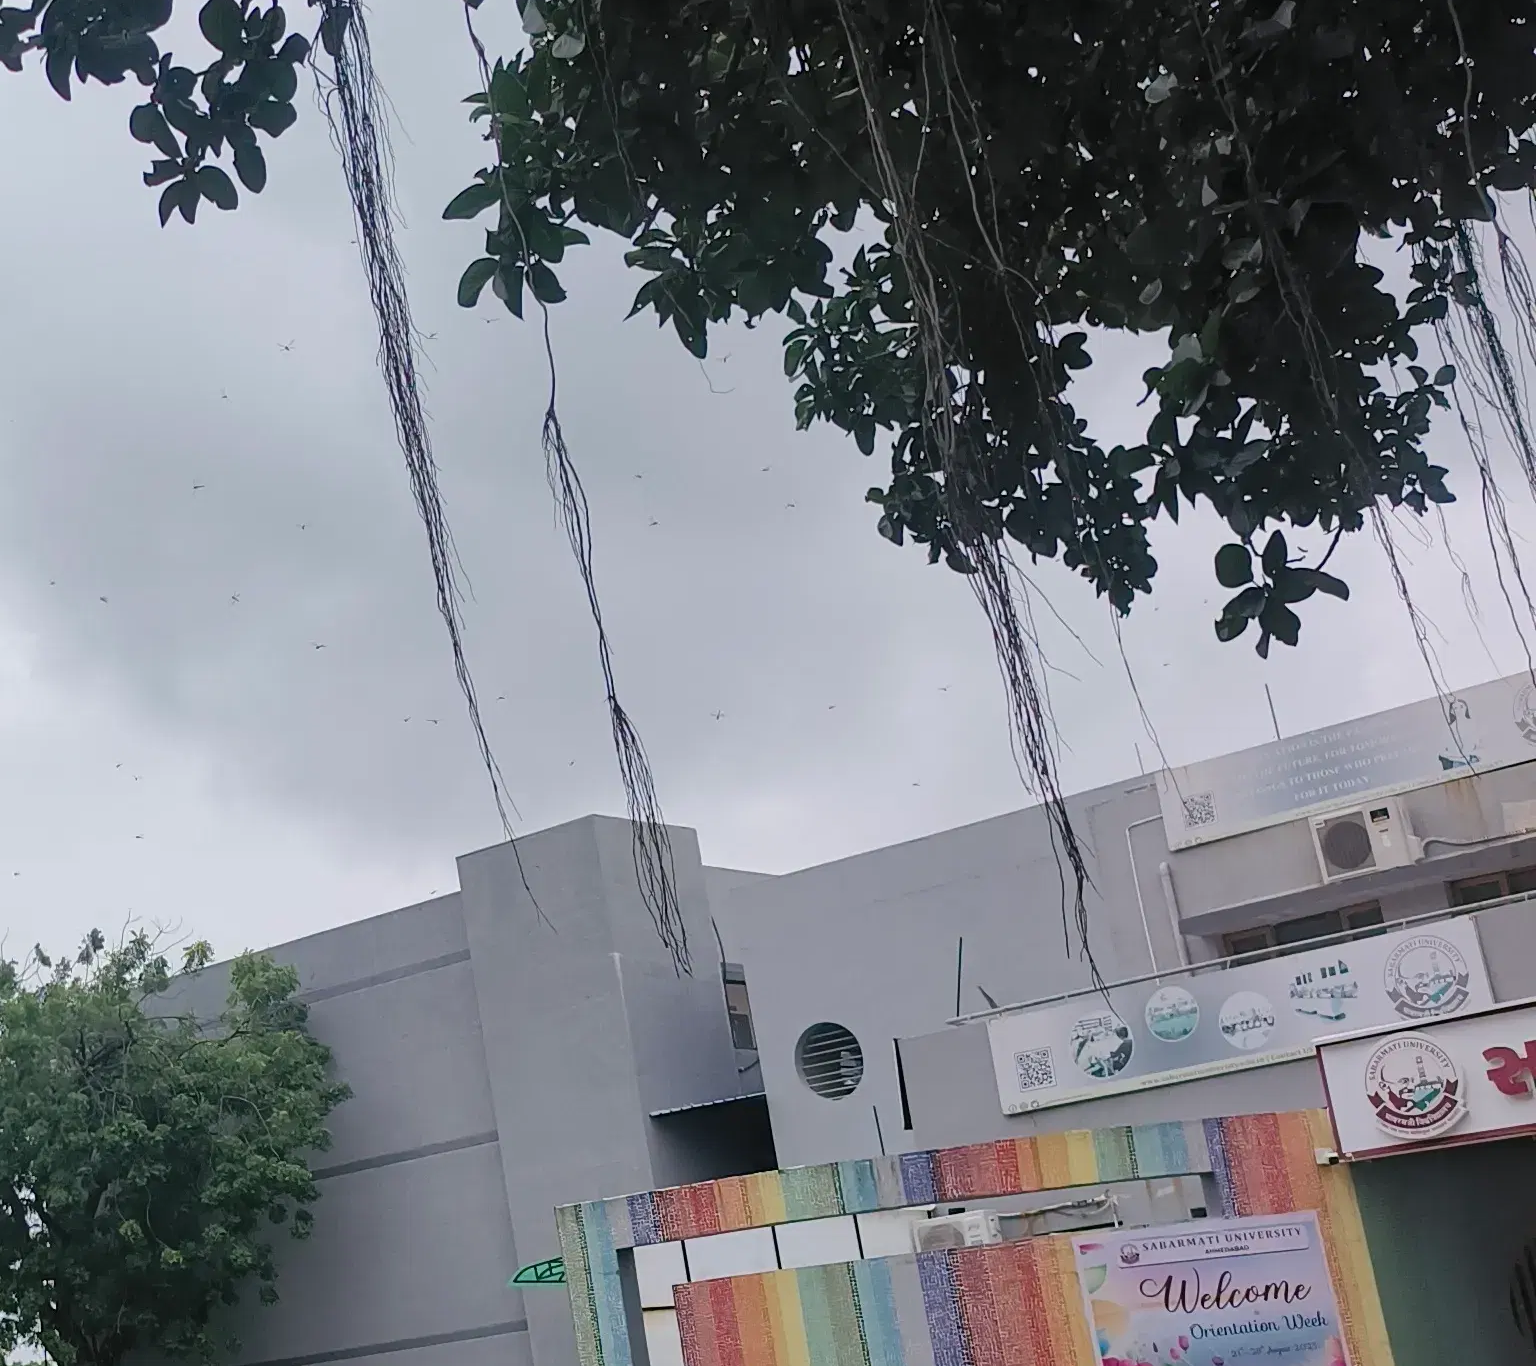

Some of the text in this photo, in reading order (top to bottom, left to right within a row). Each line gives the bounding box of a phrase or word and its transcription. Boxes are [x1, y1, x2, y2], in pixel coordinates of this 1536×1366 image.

[1368, 1041, 1450, 1081] SABARMATI UNIVERSITY
[1142, 1227, 1302, 1251] SABARMATI UNIVERSITY
[1205, 1245, 1250, 1254] AHMEDABAD
[1139, 1268, 1312, 1314] Welcome
[1189, 1310, 1329, 1340] Orientation Week
